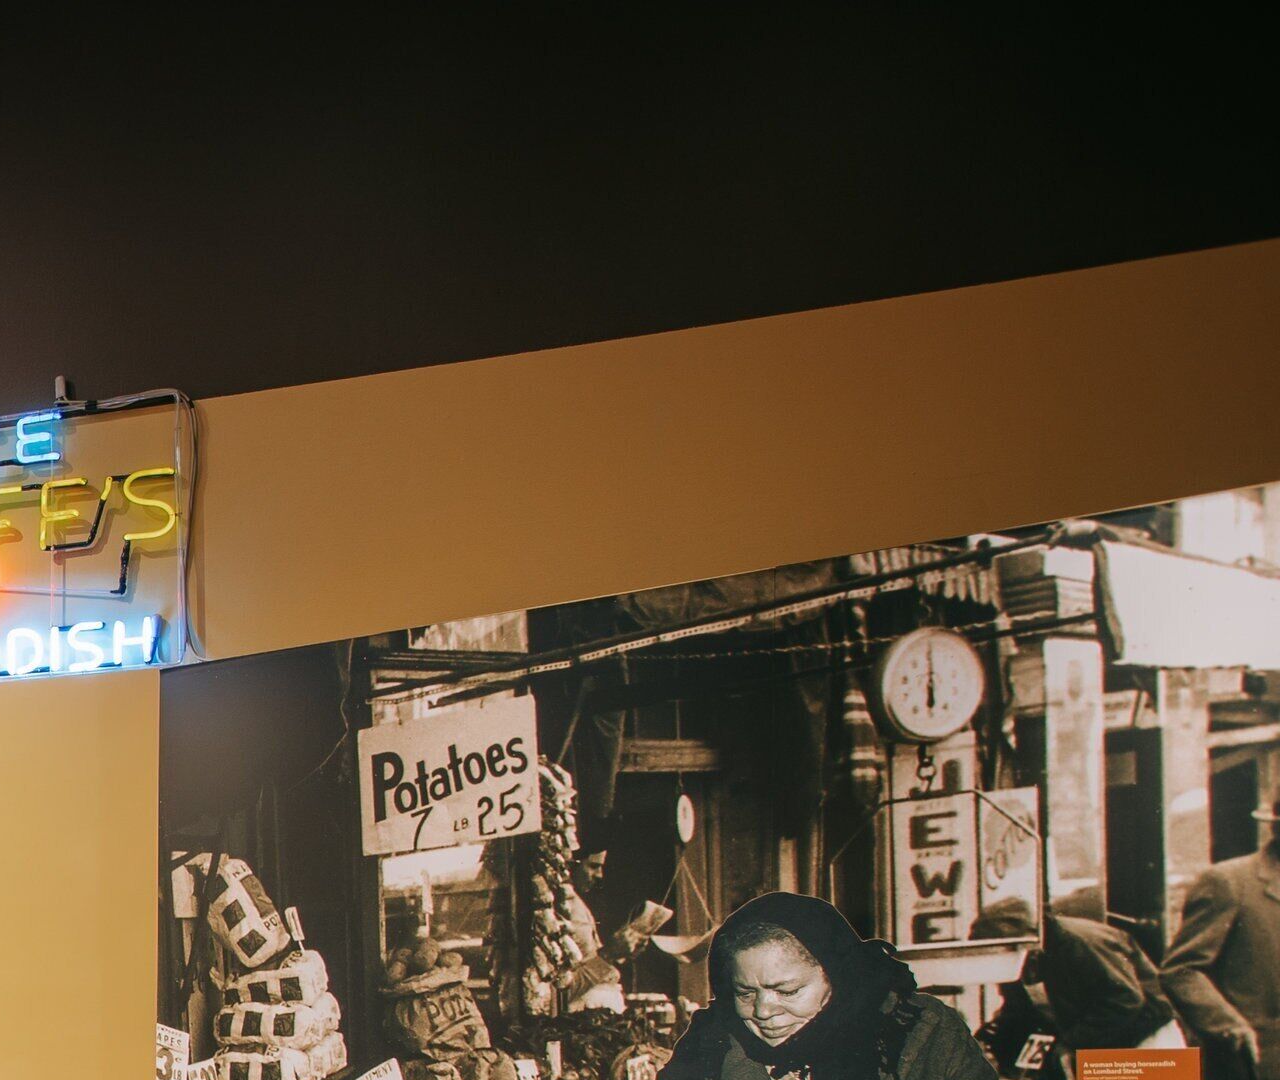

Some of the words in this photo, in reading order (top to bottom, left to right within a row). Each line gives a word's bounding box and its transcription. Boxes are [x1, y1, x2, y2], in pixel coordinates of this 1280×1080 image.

[371, 736, 529, 823] Potatoes
[410, 805, 434, 851] 7
[453, 817, 470, 832] LB
